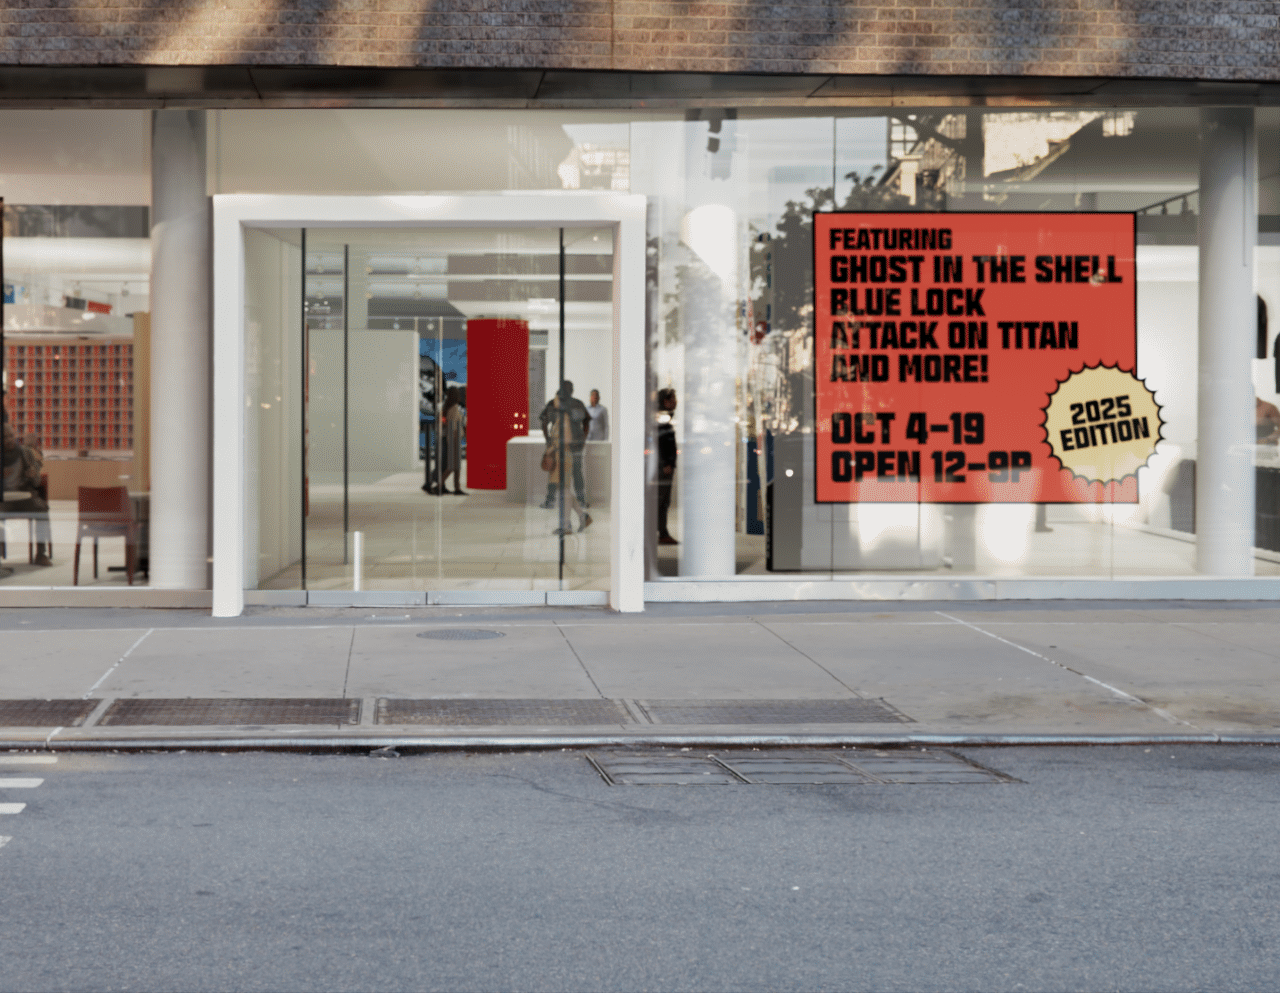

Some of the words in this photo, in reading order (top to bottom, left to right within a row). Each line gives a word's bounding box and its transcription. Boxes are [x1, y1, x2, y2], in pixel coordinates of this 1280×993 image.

[829, 228, 952, 250] FEATURING
[830, 255, 925, 283] GHOST
[933, 255, 964, 283] IN
[972, 255, 1026, 283] THE
[1035, 255, 1123, 283] SHELL
[830, 288, 901, 317] BLUE
[911, 288, 986, 317] LOCK
[830, 321, 939, 350] ATTACK
[948, 321, 989, 350] ON
[997, 321, 1079, 350] TITAN
[830, 354, 889, 383] AND
[898, 354, 989, 383] MORE!
[1069, 394, 1133, 426] 2025
[831, 412, 896, 444] OCT
[1059, 416, 1151, 452] EDITION
[831, 451, 921, 483] OPEN
